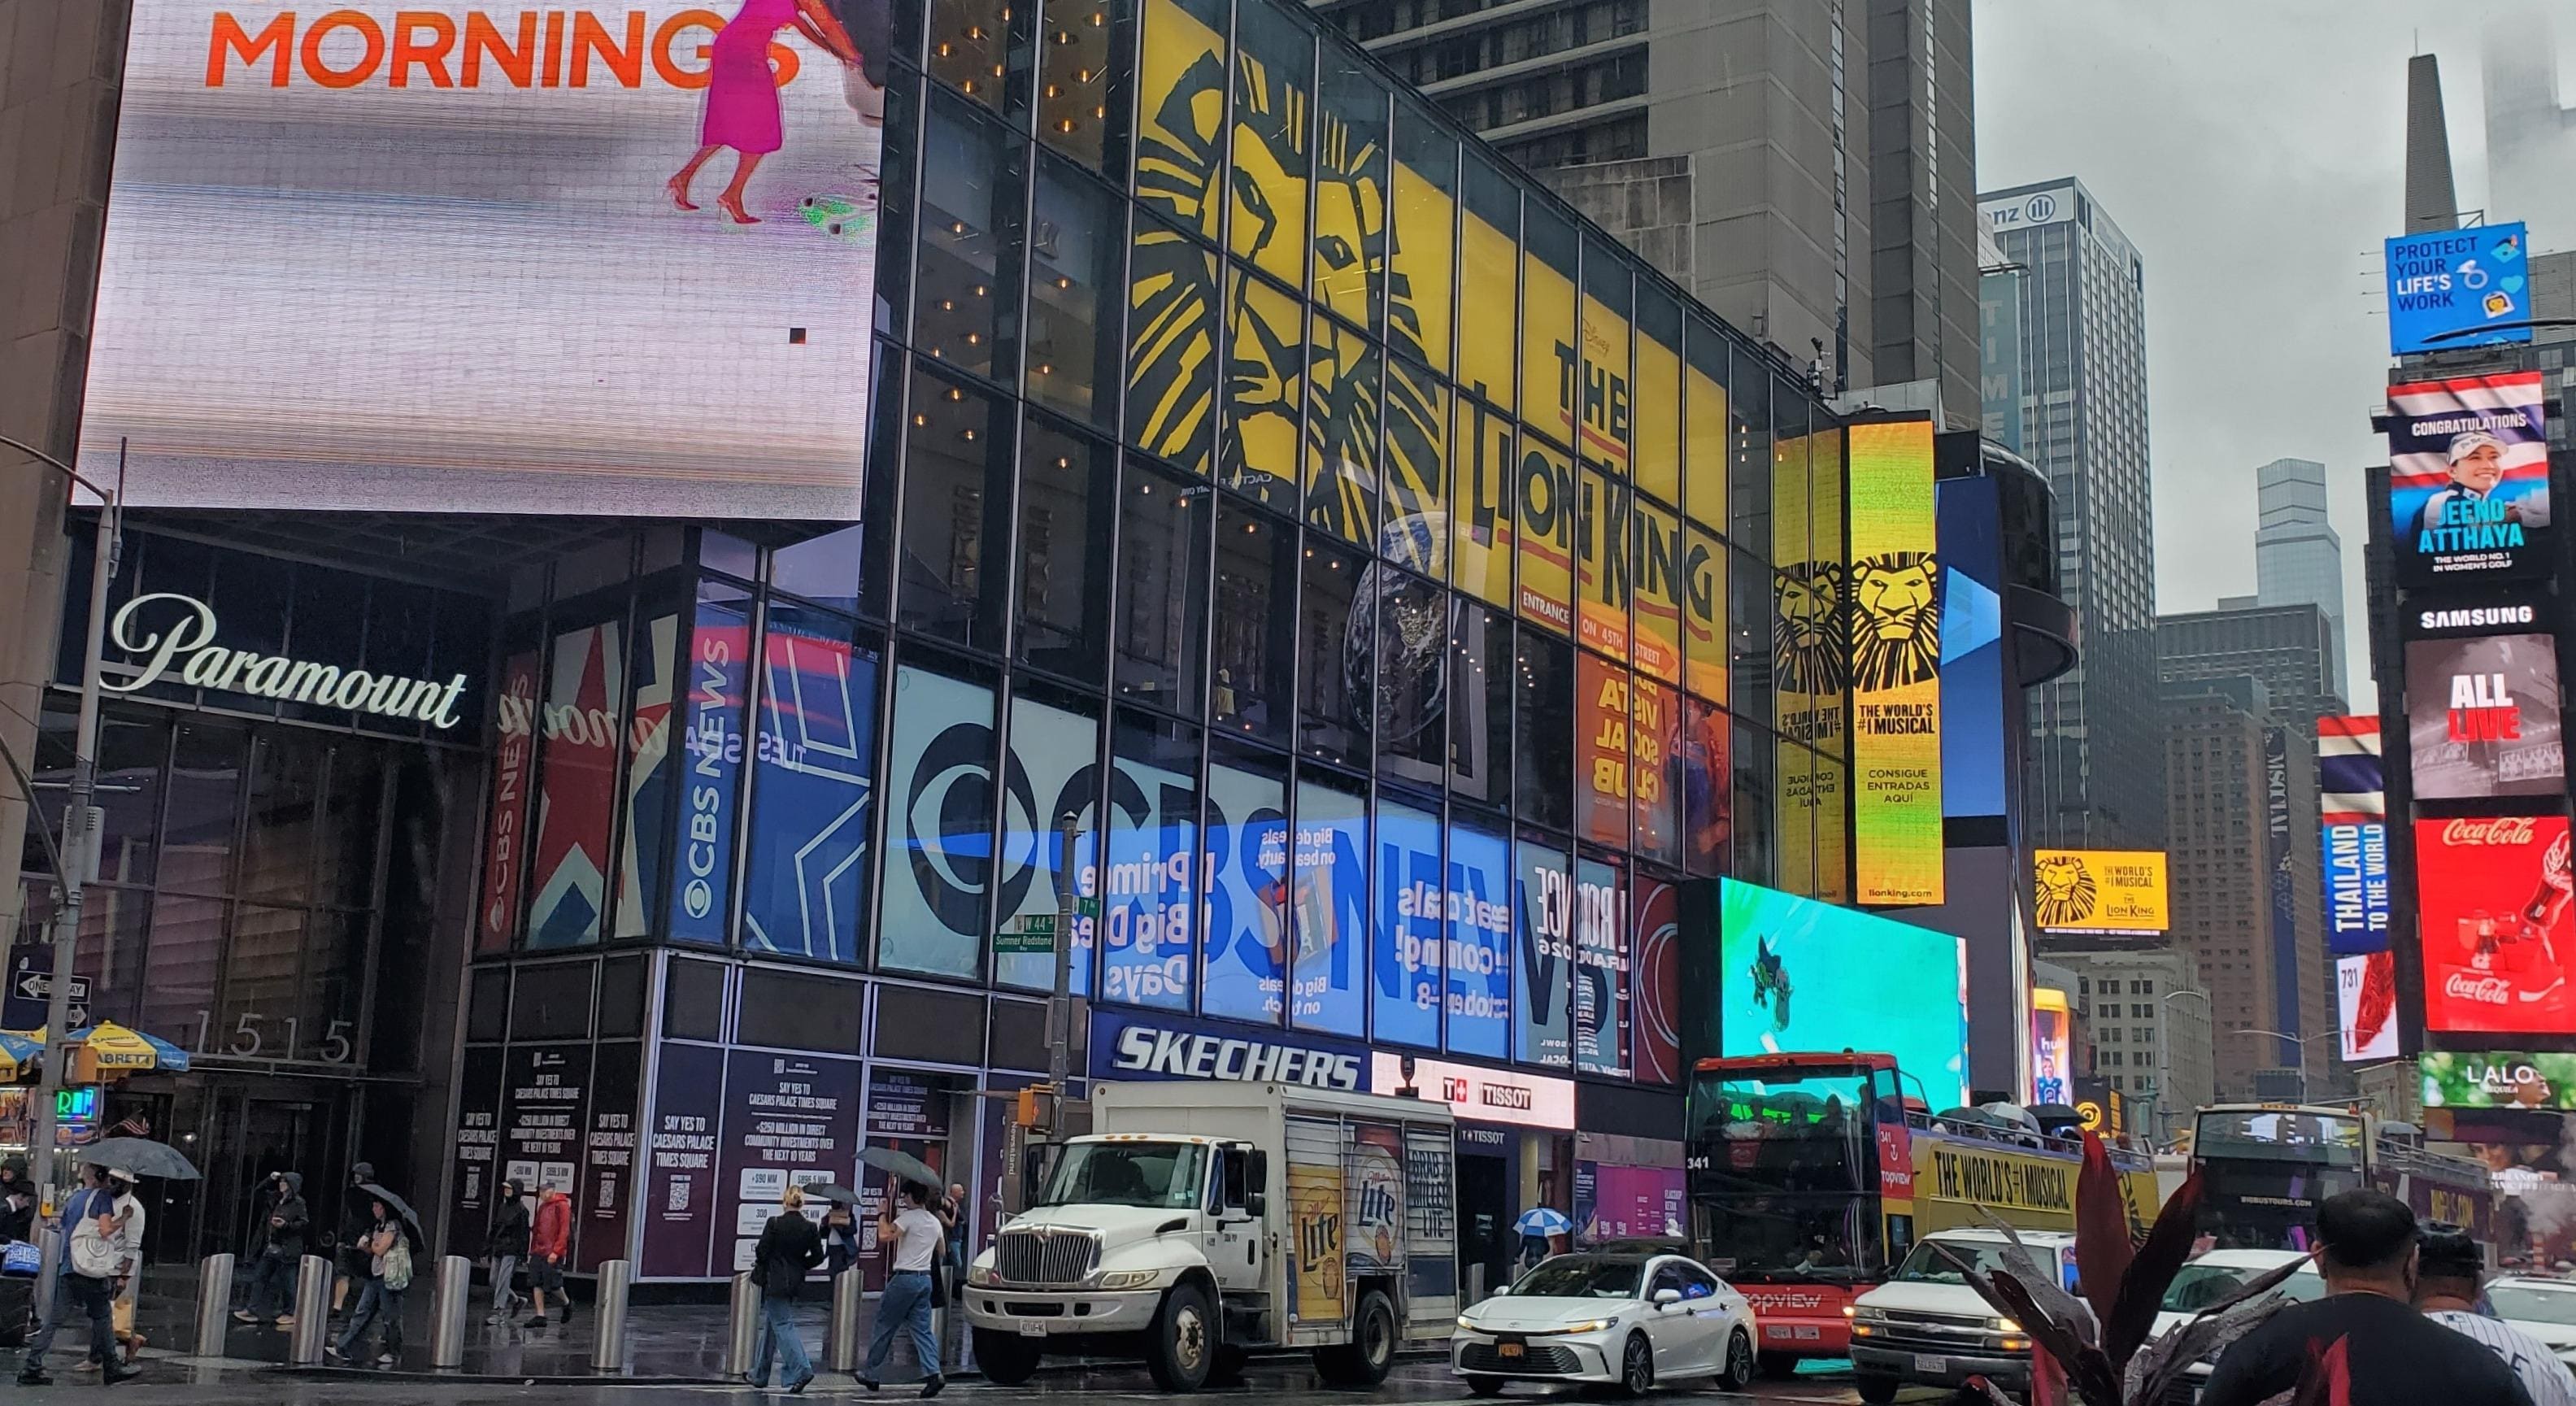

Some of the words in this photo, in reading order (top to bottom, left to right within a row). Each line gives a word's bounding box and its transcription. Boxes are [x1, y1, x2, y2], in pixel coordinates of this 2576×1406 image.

[205, 11, 799, 89] MORNINGS
[2395, 236, 2478, 261] PROTECT
[2395, 258, 2447, 276] YOUR
[2396, 273, 2452, 295] LIFE'S
[2397, 291, 2454, 312] WORK
[1555, 339, 1629, 444] THE
[2412, 413, 2526, 437] CONGRATULATIONS
[1472, 380, 1592, 563] LION
[2437, 498, 2505, 525] JEENO
[1603, 458, 1712, 623] KING
[2418, 522, 2525, 553] ATTHAYA
[2435, 555, 2452, 564] THE
[2453, 554, 2487, 563] WORLD
[2444, 561, 2487, 571] WOMEN'S
[2488, 559, 2513, 568] GOLF
[1523, 591, 1569, 625] ENTRANCE
[2421, 606, 2532, 629] SAMSUNG
[1582, 619, 1596, 637] ON
[1602, 627, 1623, 649] 45TH
[1634, 642, 1660, 665] STREET
[99, 593, 468, 729] Paramount
[2451, 673, 2513, 709] ALL
[696, 638, 729, 777] NEWS
[1860, 704, 1879, 718] THE
[1884, 703, 1933, 718] WORLD'S
[1873, 718, 1935, 735] MUSICAL
[2448, 707, 2520, 742] LIVE
[1869, 769, 1928, 778] CONSIGUE
[1867, 781, 1930, 790] ENTRADAS
[1884, 794, 1912, 803] AQUÍ
[688, 785, 720, 877] CBS
[2443, 817, 2537, 846] Coca-Cola
[497, 812, 512, 895] CBS
[2364, 823, 2387, 876] WORLD
[2115, 866, 2153, 876] WORLD'S
[2331, 825, 2364, 934] THAILAND
[2115, 877, 2153, 888] MUSICAL
[1869, 889, 1932, 899] lionking.com
[2124, 896, 2135, 904] THE
[2369, 879, 2387, 908] THE
[1083, 899, 1089, 913] 7
[2107, 904, 2128, 917] LION
[2130, 905, 2155, 918] KING
[1025, 916, 1033, 928] W
[1034, 916, 1046, 931] 44
[2369, 912, 2387, 932] TO
[996, 936, 1020, 946] Sumner
[1022, 935, 1052, 946] Redstone
[28, 980, 47, 992] ONE
[70, 985, 82, 995] AY
[2341, 969, 2358, 989] 731
[2446, 973, 2511, 1005] Coca-Cola
[198, 1010, 352, 1063] 1515
[97, 1053, 154, 1065] ABRETT
[1112, 1026, 1361, 1091] SKECHERS
[2467, 1064, 2534, 1084] LALO
[779, 1082, 790, 1094] SAY
[791, 1082, 803, 1095] YES
[803, 1083, 811, 1095] TO
[1483, 1084, 1530, 1109] TISSOT
[749, 1093, 775, 1106] CAESARS
[776, 1095, 798, 1108] PALACE
[798, 1096, 815, 1108] TIMES
[816, 1097, 838, 1110] SQUARE
[664, 1115, 679, 1131] SAY
[680, 1116, 694, 1132] YES
[694, 1117, 706, 1132] TO
[652, 1134, 686, 1150] CAESARS
[686, 1135, 715, 1151] PALACE
[820, 1138, 834, 1150] OVER
[1472, 1130, 1505, 1145] TISSOT
[1880, 1130, 1891, 1143] 341
[655, 1151, 679, 1168] TIMES
[679, 1153, 709, 1169] SQUARE
[763, 1148, 774, 1160] THE
[774, 1149, 790, 1161] NEXT
[790, 1150, 797, 1162] 10
[798, 1150, 816, 1162] YEARS
[1687, 1156, 1708, 1170] 341
[1934, 1151, 1960, 1198] THE
[1960, 1154, 2013, 1205] WORLD'S
[2026, 1166, 2070, 1210] MUSICAL
[1358, 1180, 1395, 1227] Lite
[1423, 1208, 1444, 1238] LITE
[1301, 1213, 1338, 1273] Lite
